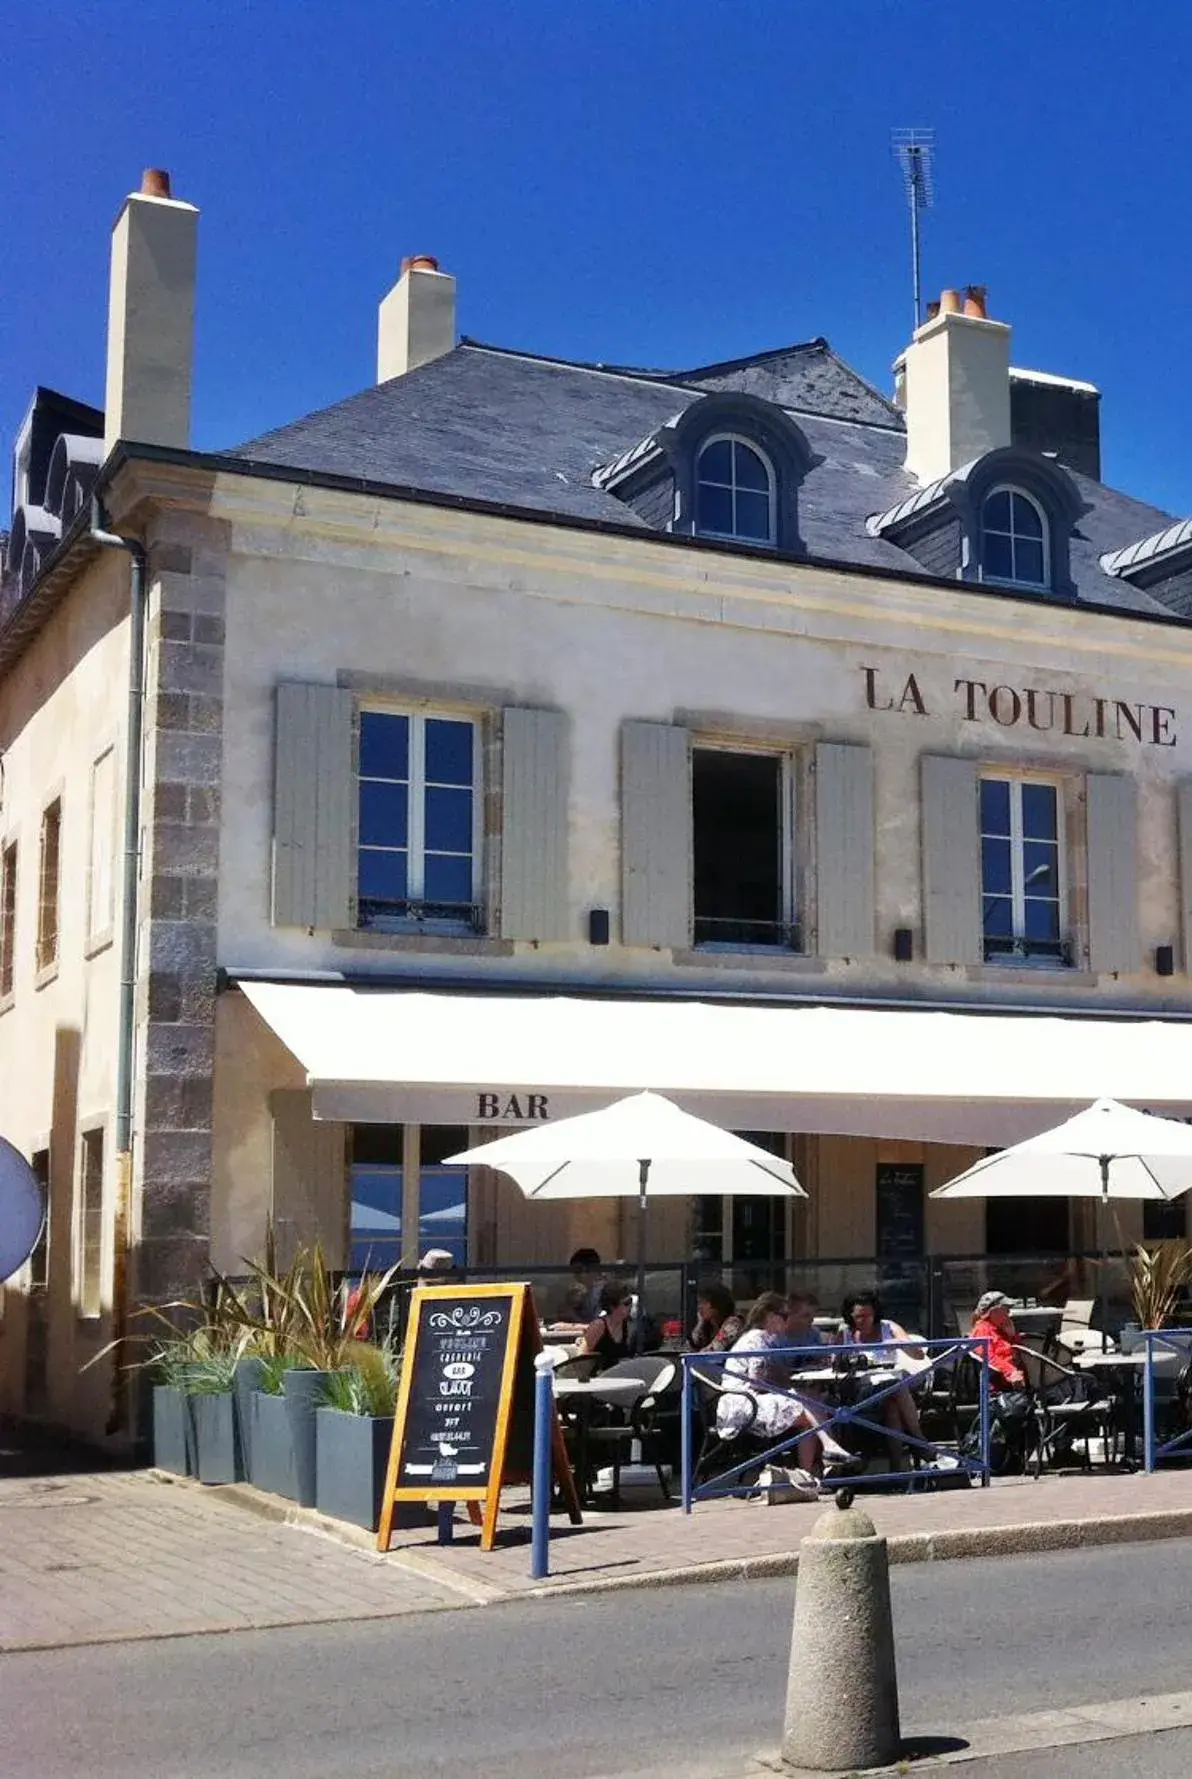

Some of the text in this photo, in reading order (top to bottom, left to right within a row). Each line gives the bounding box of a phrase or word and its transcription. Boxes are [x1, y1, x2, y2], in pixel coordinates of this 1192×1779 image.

[861, 666, 1177, 747] LA TOULINE
[476, 1093, 551, 1119] BAR
